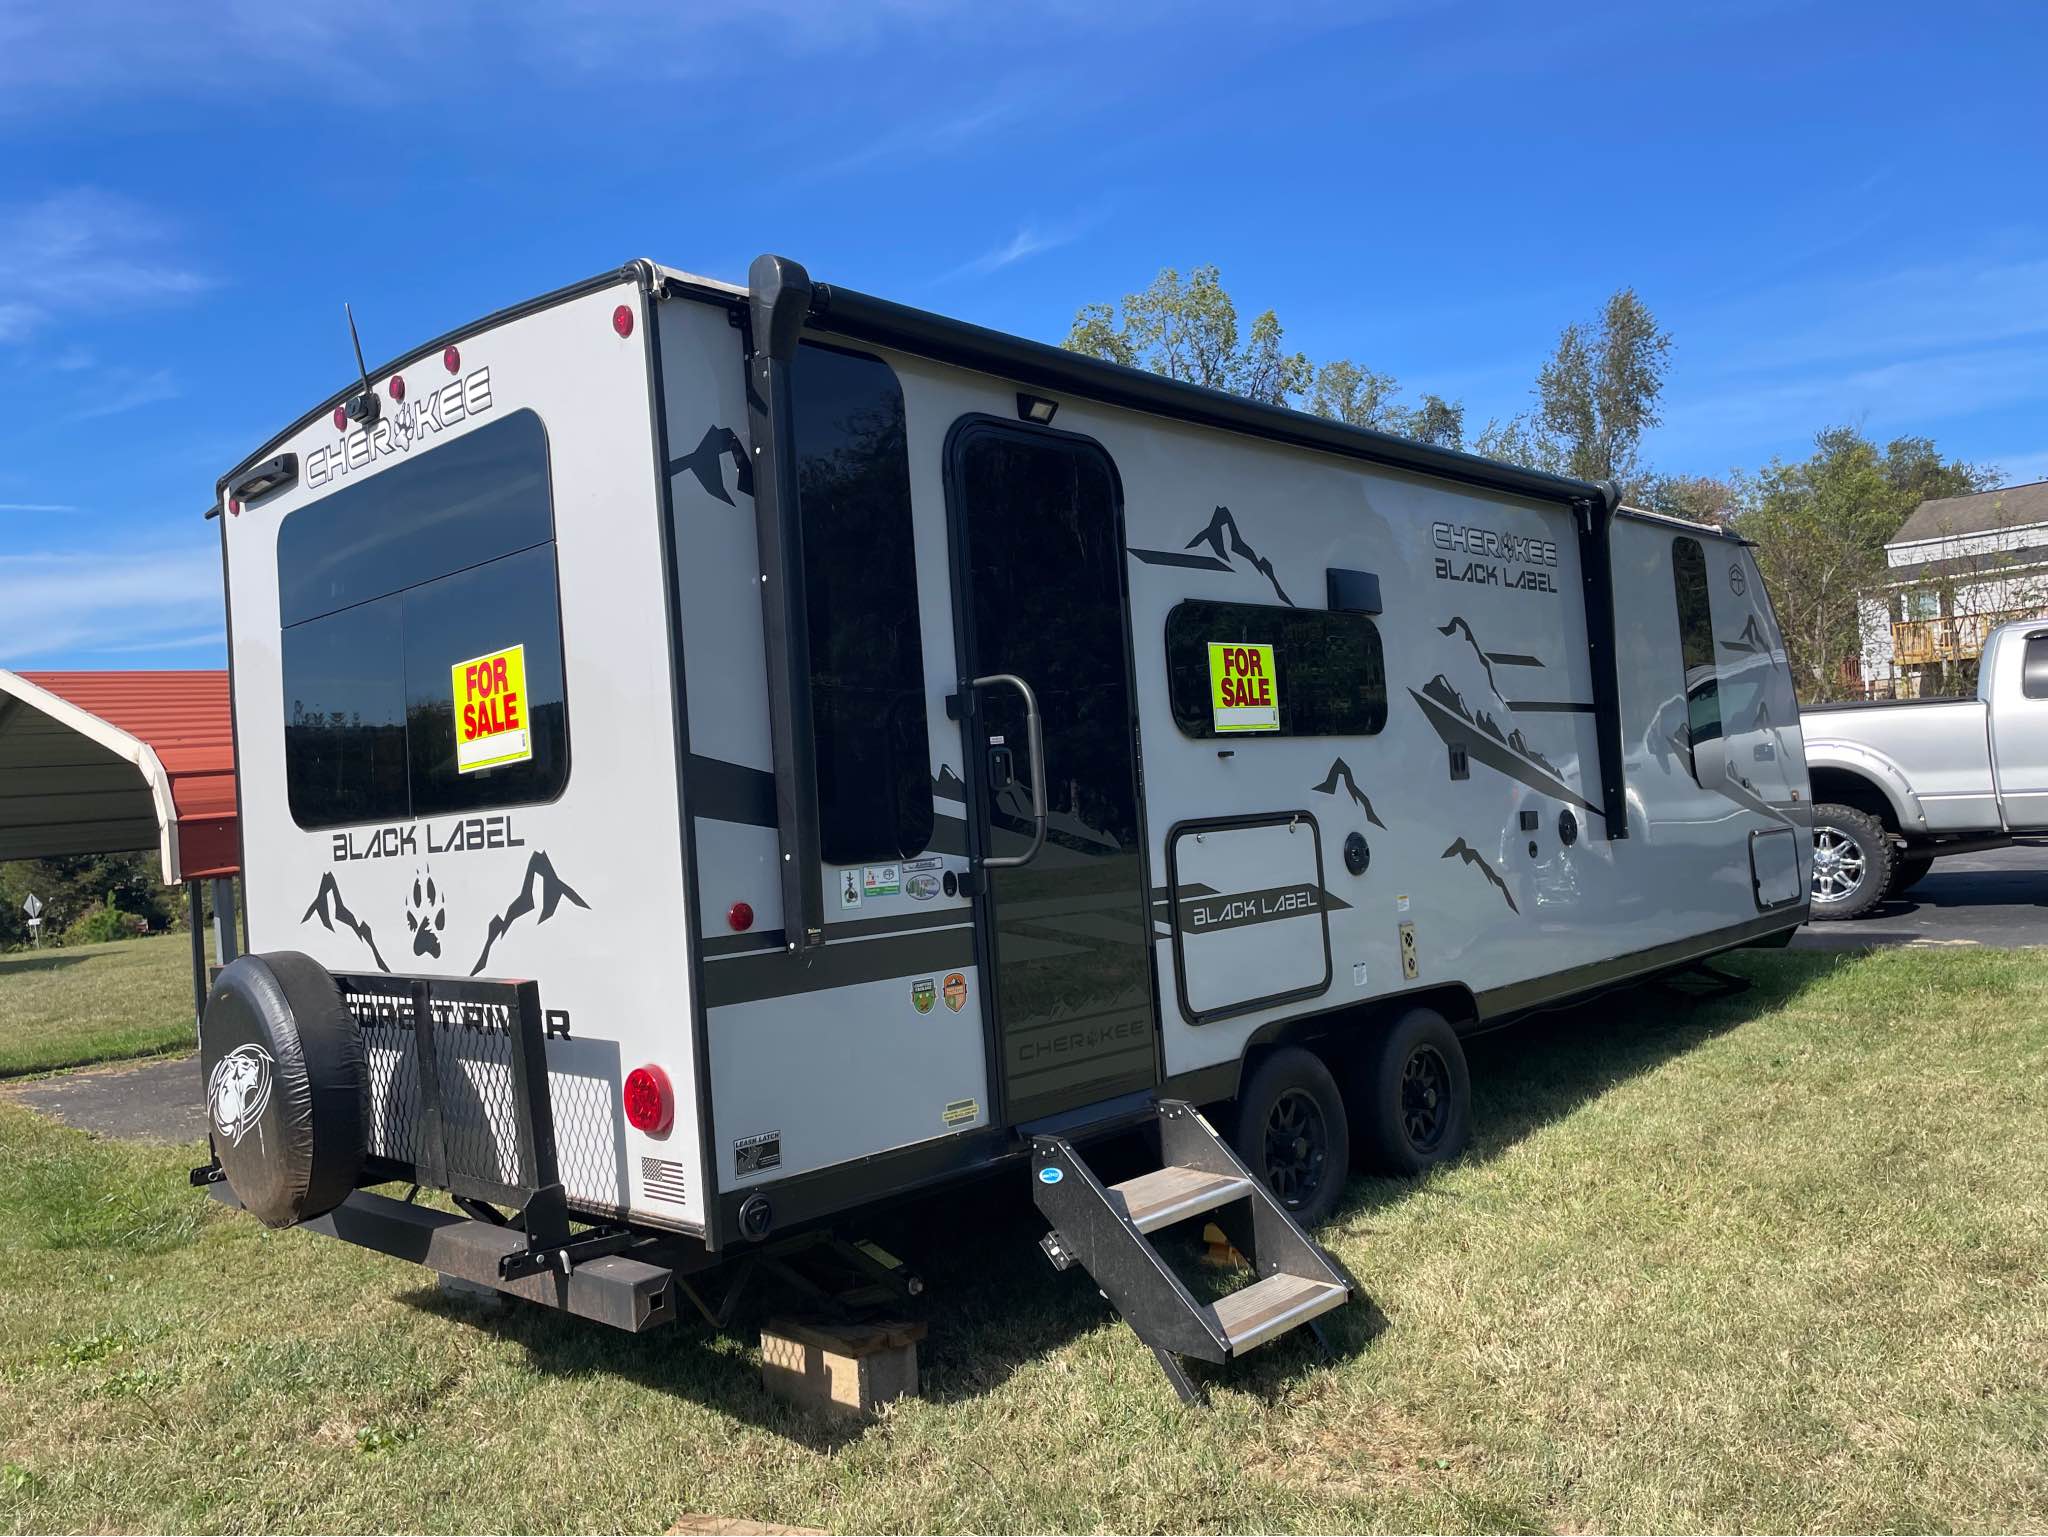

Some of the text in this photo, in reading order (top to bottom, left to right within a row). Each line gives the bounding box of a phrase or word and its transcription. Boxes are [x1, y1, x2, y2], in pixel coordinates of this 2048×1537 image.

[1435, 557, 1558, 593] BLACK LABEL
[466, 657, 509, 702] FOR
[1223, 648, 1263, 677] FOR
[1221, 677, 1271, 707] SALE
[464, 693, 519, 740] SALE
[333, 816, 525, 862] BLACK LABEL
[1193, 891, 1318, 926] BLACK LABEL
